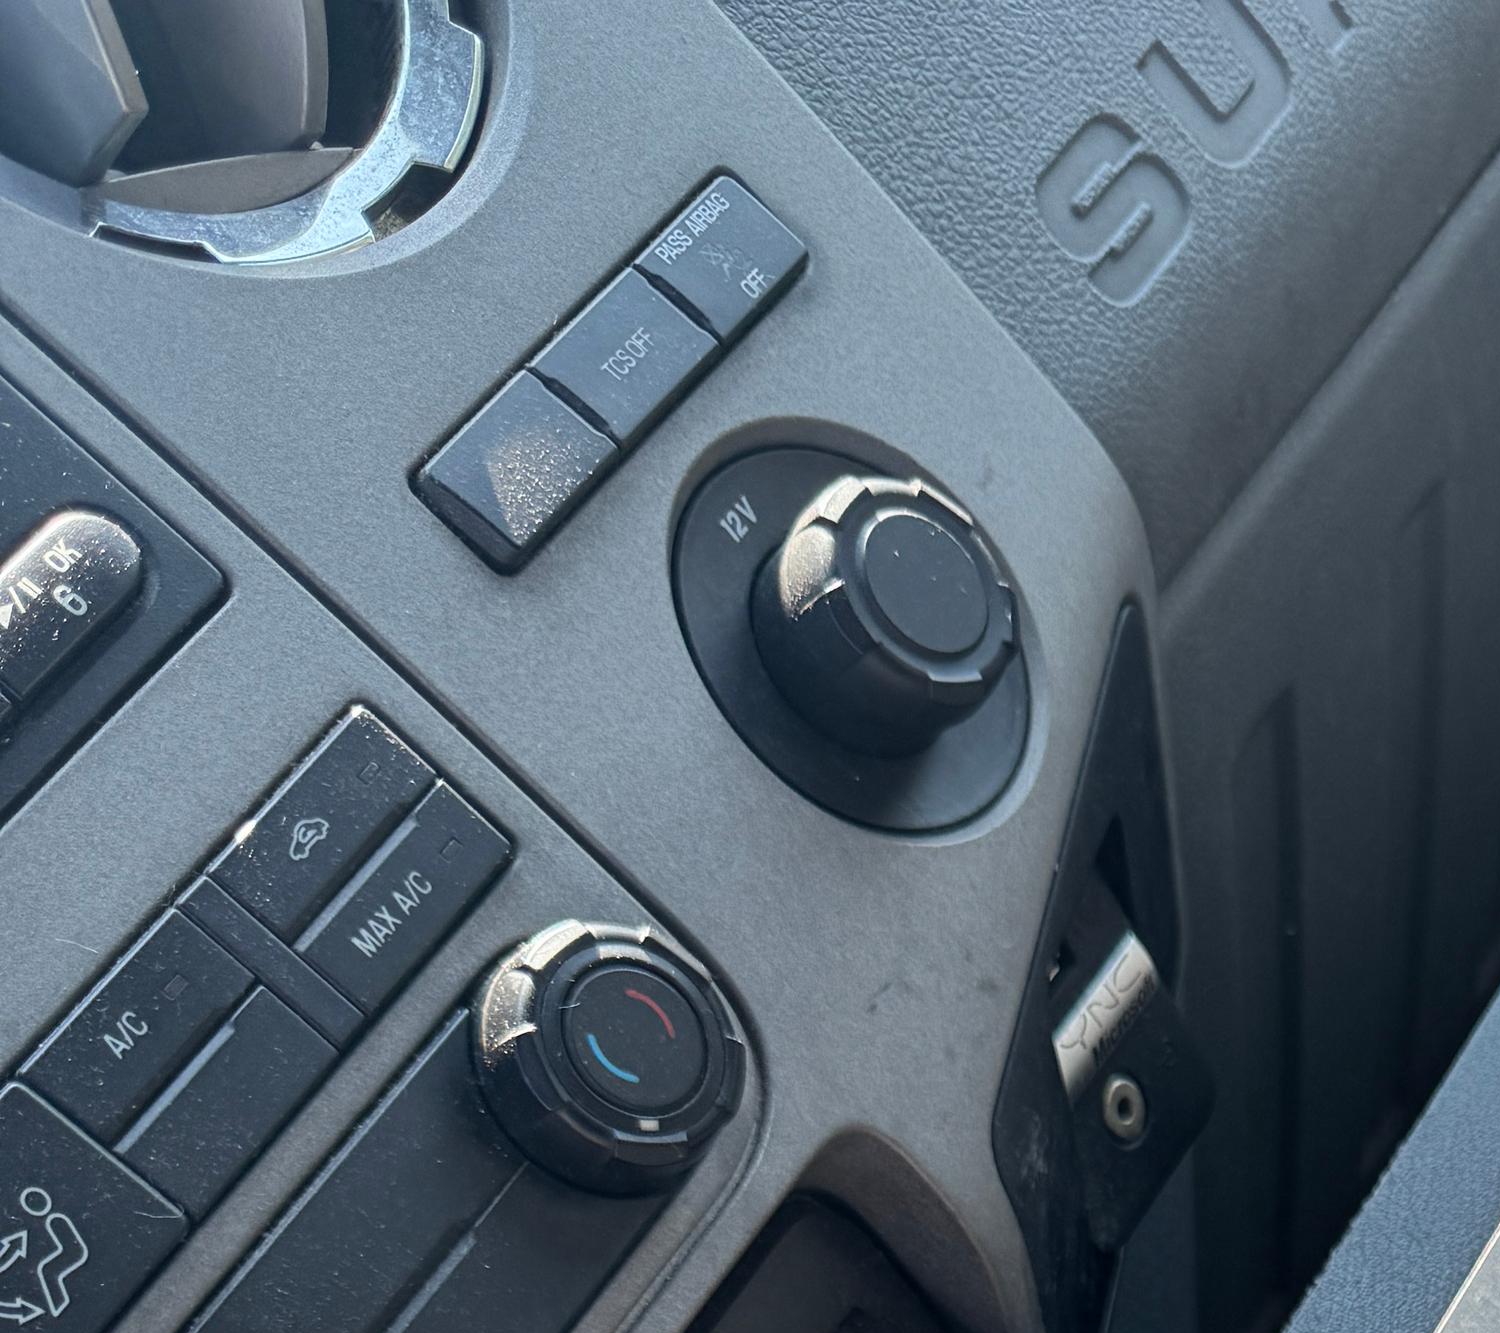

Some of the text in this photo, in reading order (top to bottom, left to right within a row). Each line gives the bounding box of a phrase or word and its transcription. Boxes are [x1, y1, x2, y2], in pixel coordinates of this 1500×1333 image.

[655, 191, 730, 265] PASS AIRBAG
[740, 268, 767, 298] OFF
[601, 326, 654, 382] TCS OFF
[719, 495, 757, 542] 12V
[45, 539, 82, 572] OK
[53, 585, 87, 615] 6
[350, 870, 432, 957] MAX A/C
[103, 1011, 149, 1060] A/C
